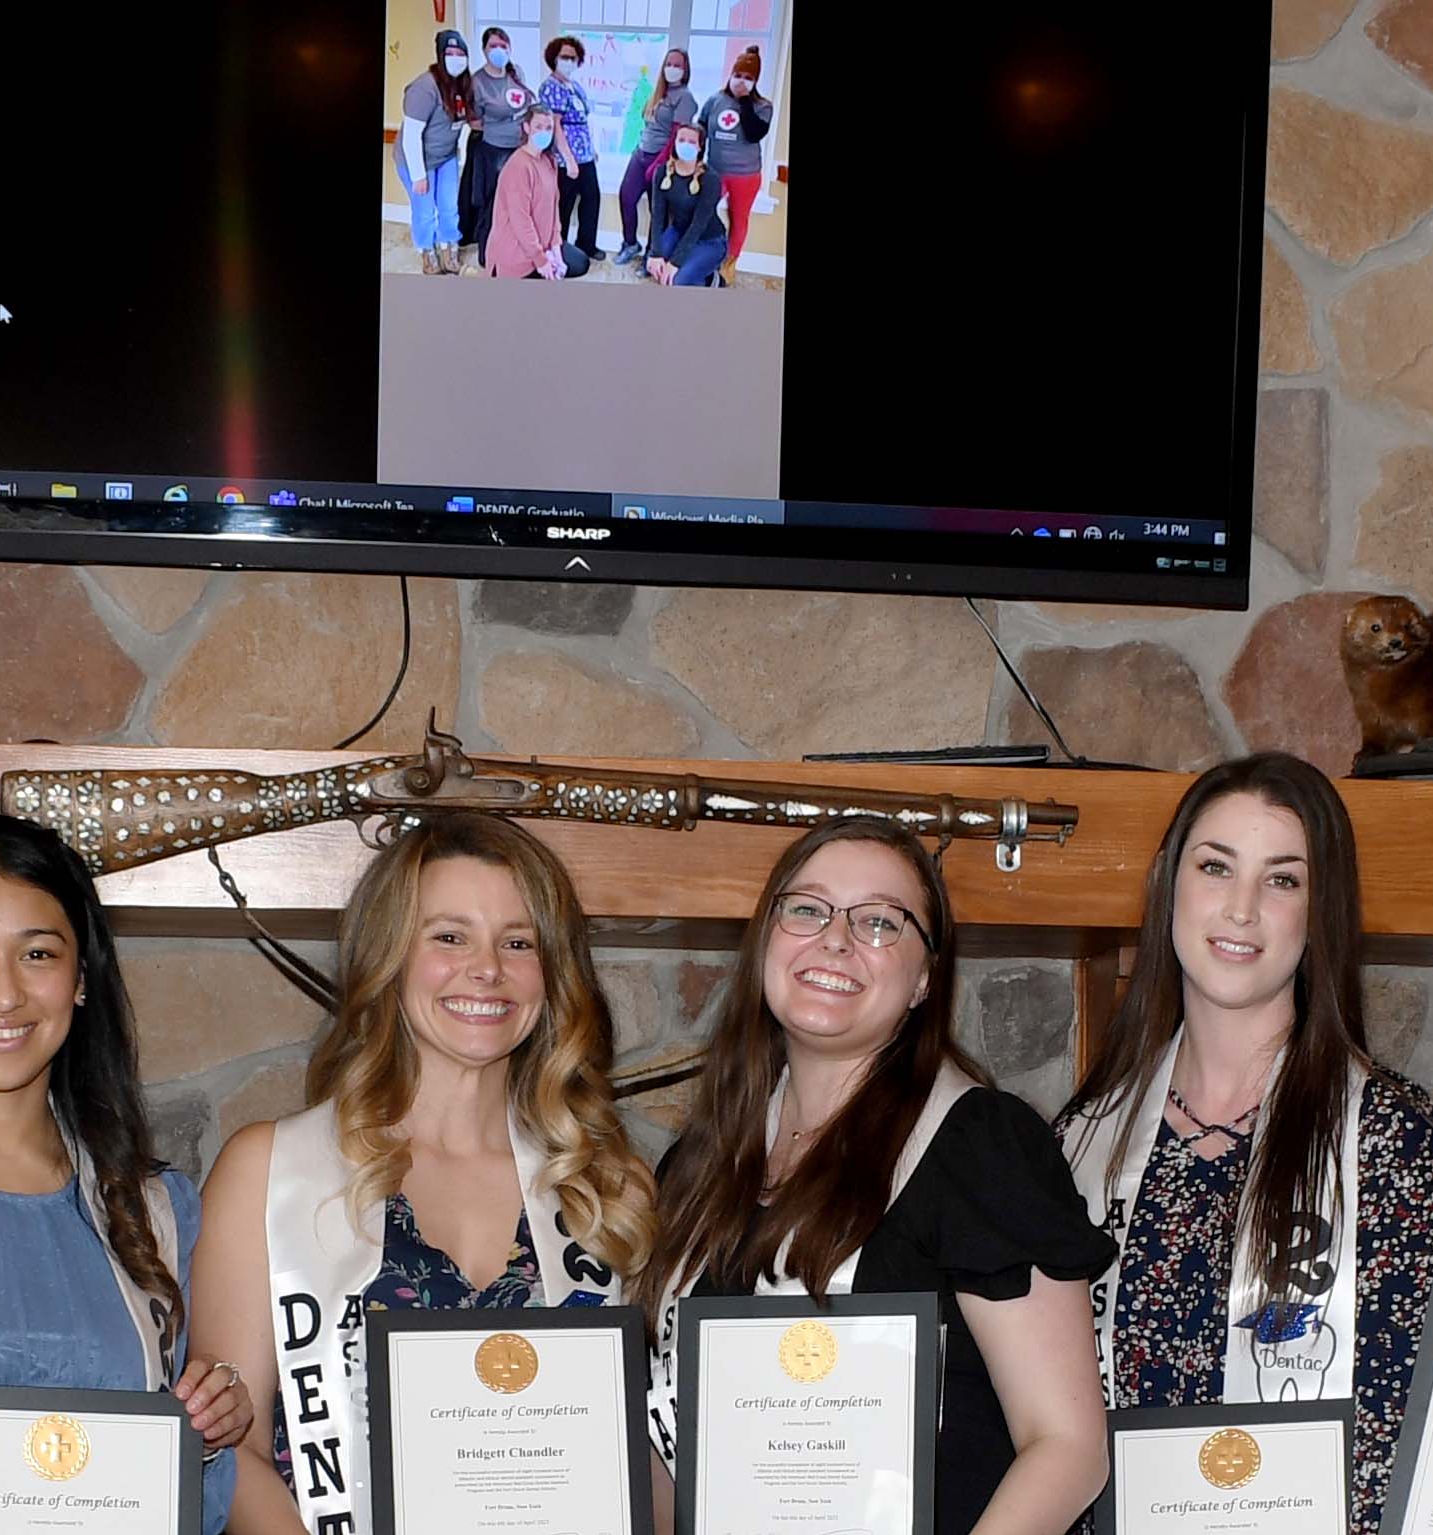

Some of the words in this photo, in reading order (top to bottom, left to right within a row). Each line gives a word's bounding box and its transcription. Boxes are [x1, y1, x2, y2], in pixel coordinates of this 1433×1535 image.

[546, 526, 611, 540] SHARP
[1143, 522, 1168, 536] 3:44
[1170, 524, 1190, 537] PM
[1259, 1348, 1323, 1372] Dentac
[734, 1396, 797, 1412] Certificate
[800, 1396, 815, 1411] of
[815, 1395, 882, 1412] Completion
[429, 1406, 497, 1422] Certificate
[501, 1405, 515, 1421] of
[517, 1404, 589, 1420] Completion
[457, 1448, 505, 1461] Bridgett
[509, 1446, 565, 1458] Chandler
[768, 1439, 804, 1453] Kelsey
[806, 1439, 846, 1451] Gaskill
[48, 1494, 63, 1510] of
[64, 1495, 141, 1511] Completion
[1150, 1499, 1220, 1516] Certificate
[1222, 1498, 1238, 1514] of
[1239, 1496, 1314, 1511] Completion
